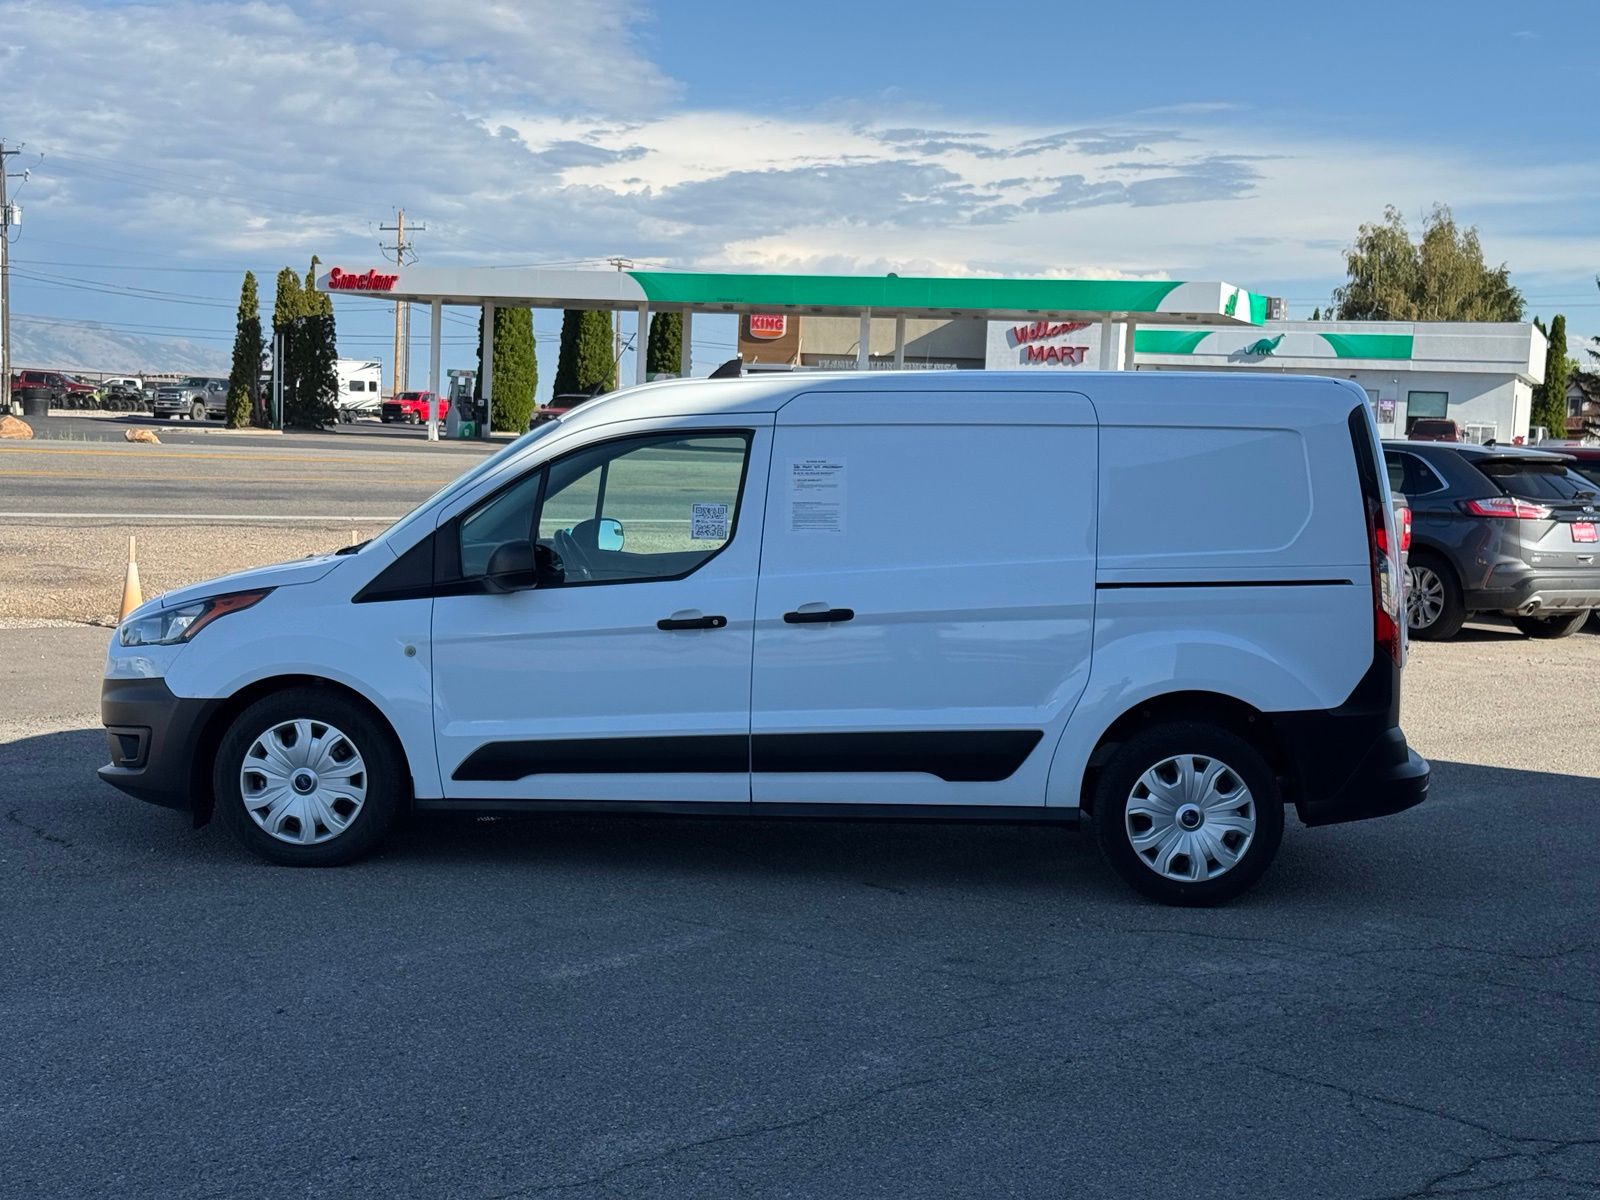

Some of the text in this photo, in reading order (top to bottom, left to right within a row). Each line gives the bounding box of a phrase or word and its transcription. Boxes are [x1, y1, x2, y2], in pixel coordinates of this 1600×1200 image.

[328, 267, 398, 291] Sinclair
[751, 318, 784, 330] KING
[1027, 345, 1089, 363] MART
